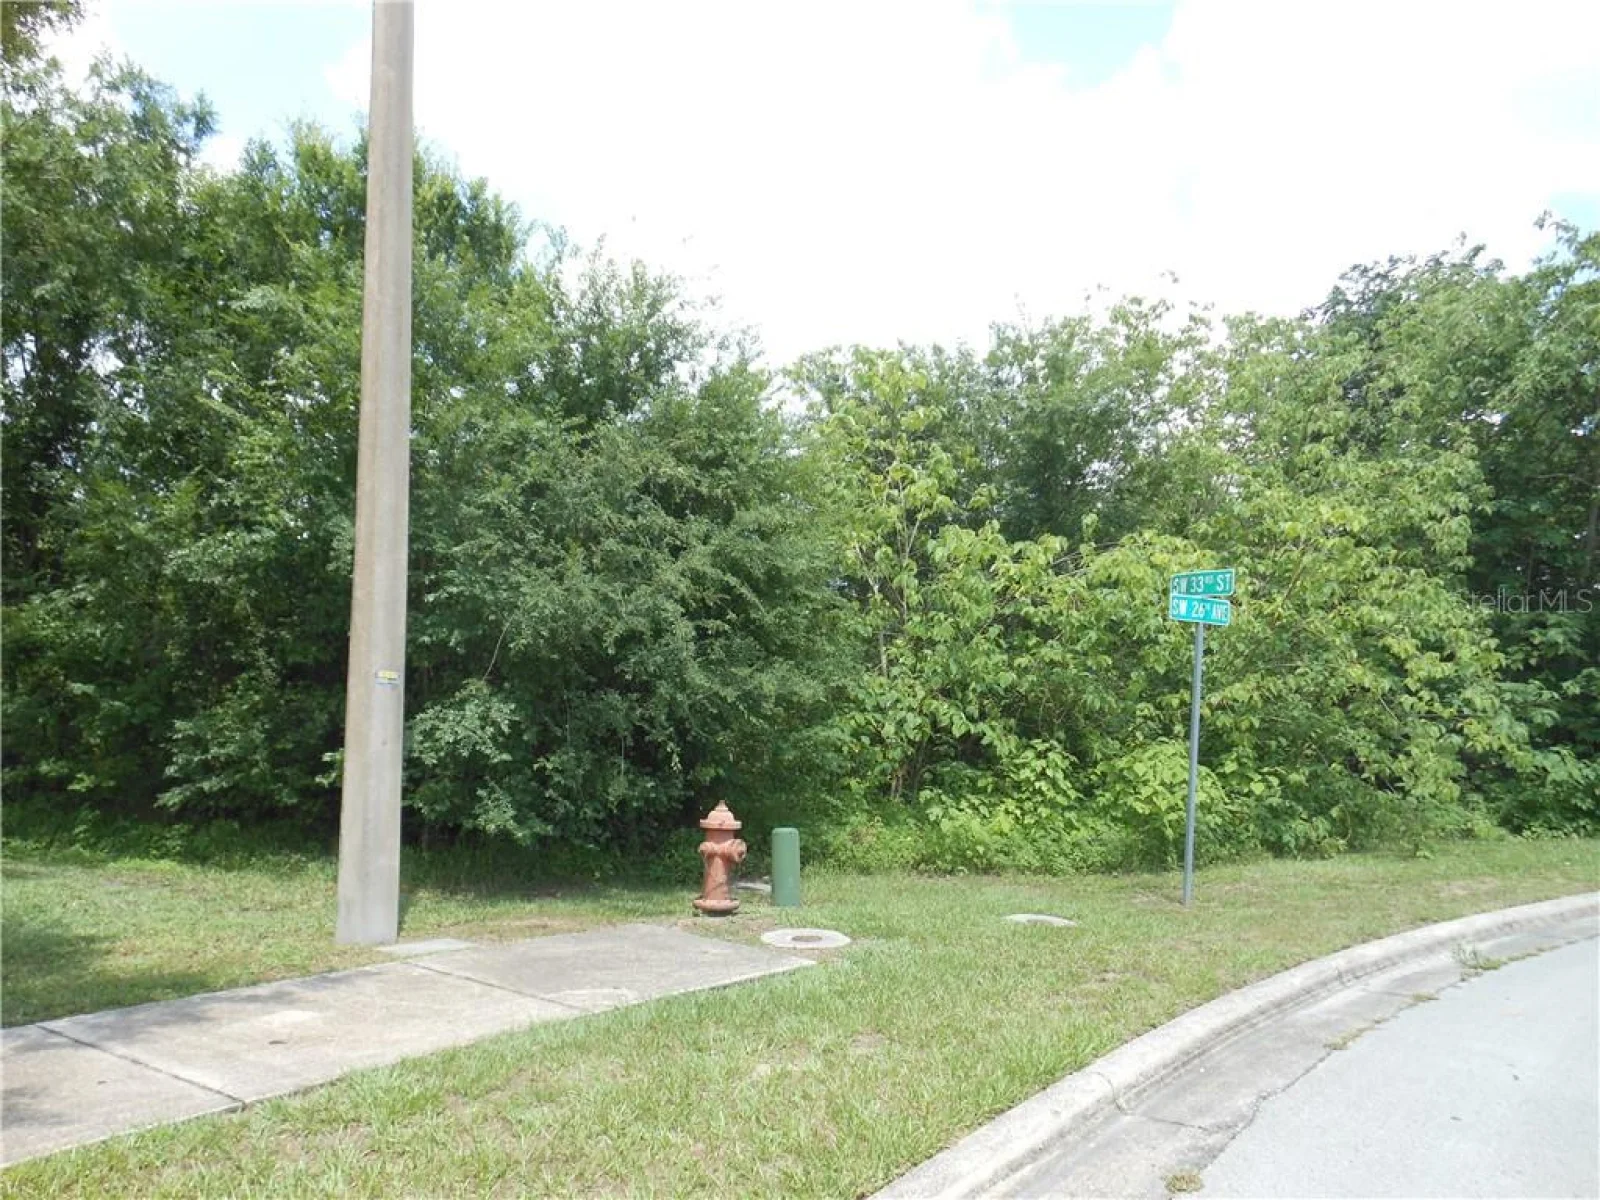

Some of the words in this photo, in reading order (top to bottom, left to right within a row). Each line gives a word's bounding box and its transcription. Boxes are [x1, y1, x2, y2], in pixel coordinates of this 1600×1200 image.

[1172, 577, 1188, 594] SW
[1216, 573, 1231, 592] ST
[1172, 598, 1188, 616] SW
[1211, 602, 1229, 621] AVE
